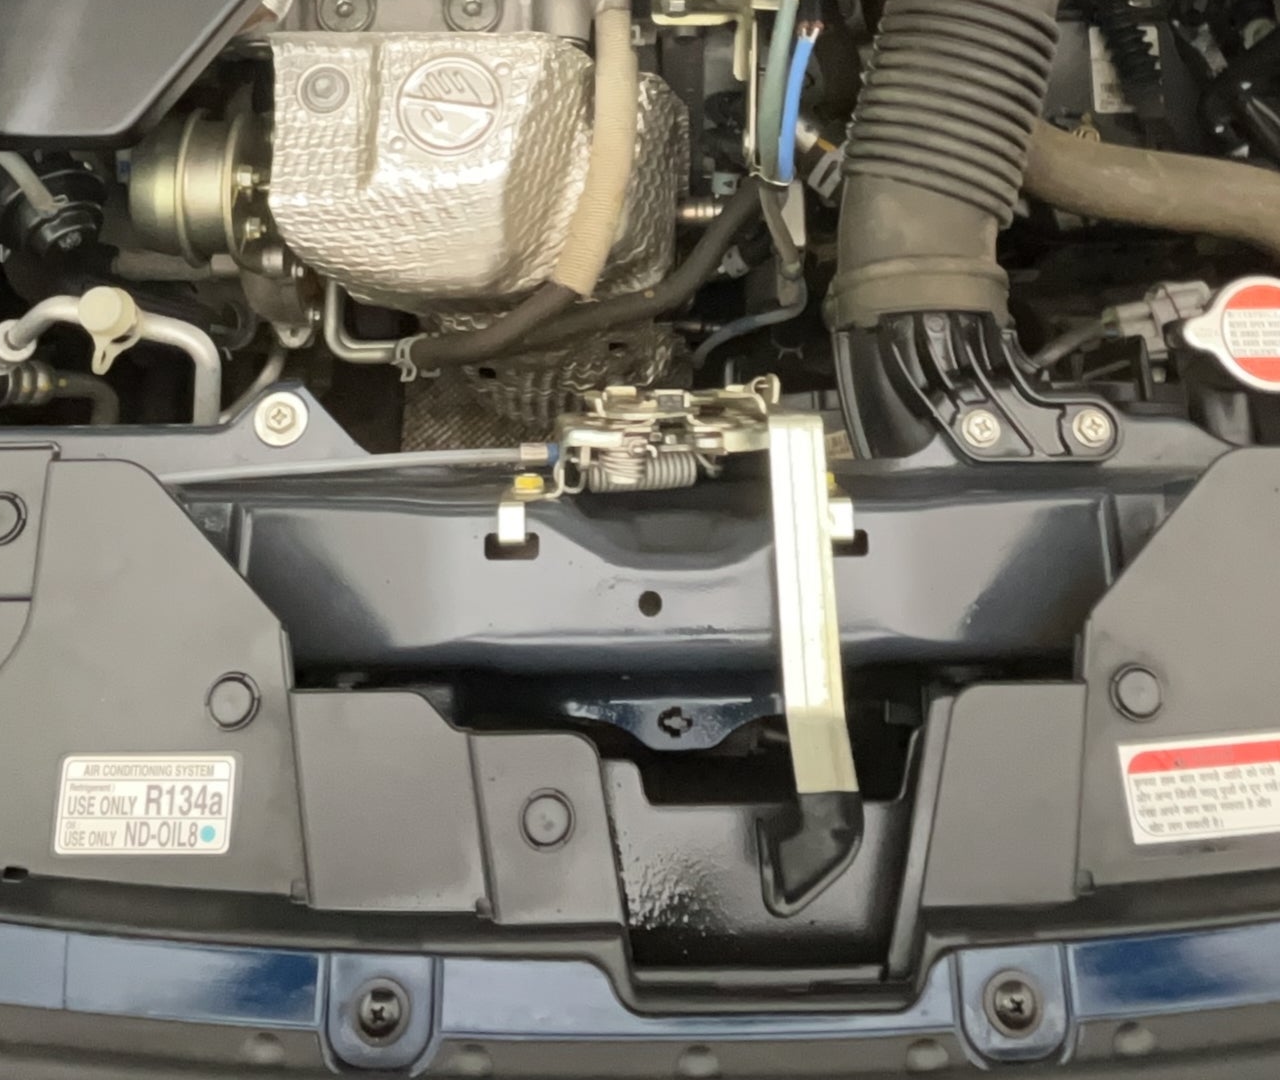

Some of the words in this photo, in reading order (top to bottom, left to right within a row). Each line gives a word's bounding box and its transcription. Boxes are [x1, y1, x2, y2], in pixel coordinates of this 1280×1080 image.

[84, 765, 100, 776] AIR
[103, 765, 172, 776] CONDITIONING
[175, 765, 214, 776] SYSTEM
[68, 796, 95, 815] USE
[100, 795, 137, 815] ONLY
[144, 784, 222, 816] R134a
[65, 831, 86, 846] USE
[88, 831, 117, 846] ONLY
[124, 821, 198, 847] ND-OIL8
